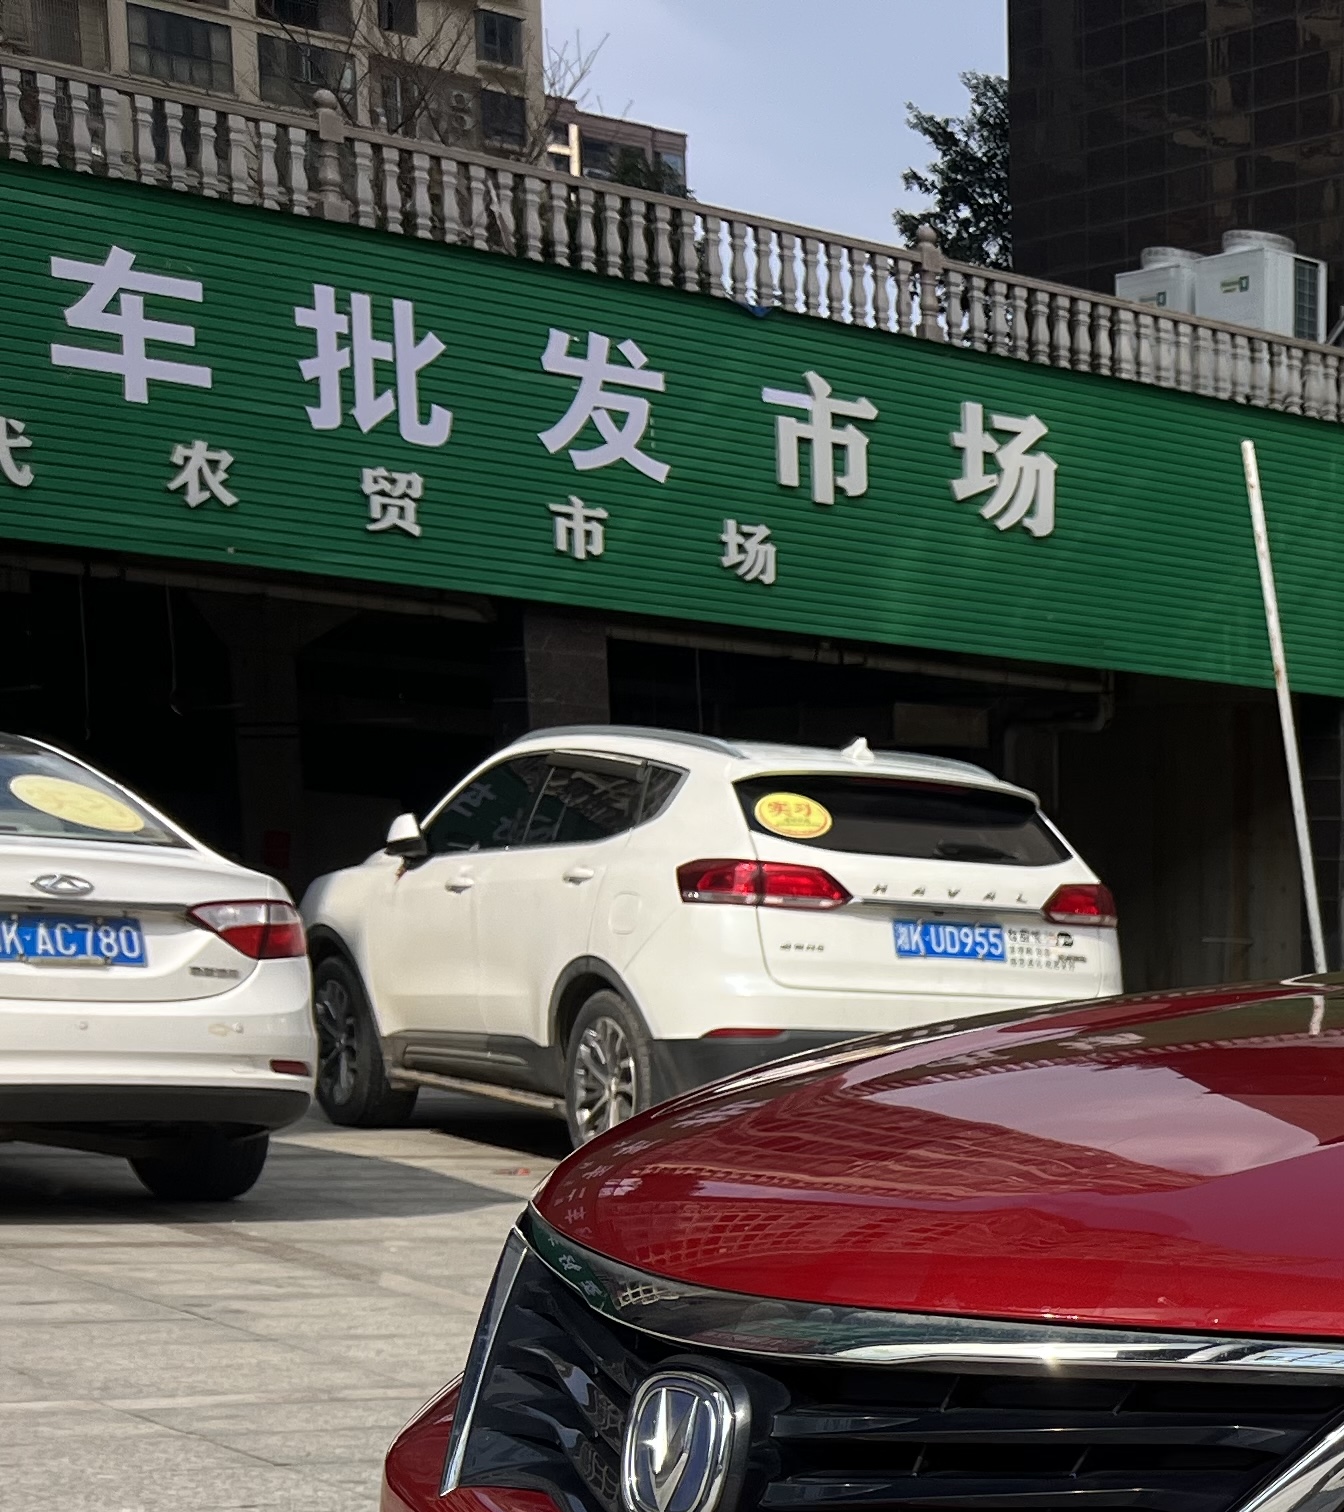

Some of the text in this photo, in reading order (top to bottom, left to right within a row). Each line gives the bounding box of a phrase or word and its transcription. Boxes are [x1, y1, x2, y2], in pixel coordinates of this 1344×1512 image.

[50, 245, 1058, 538] 车批发市场
[873, 884, 1027, 903] HAVAL
